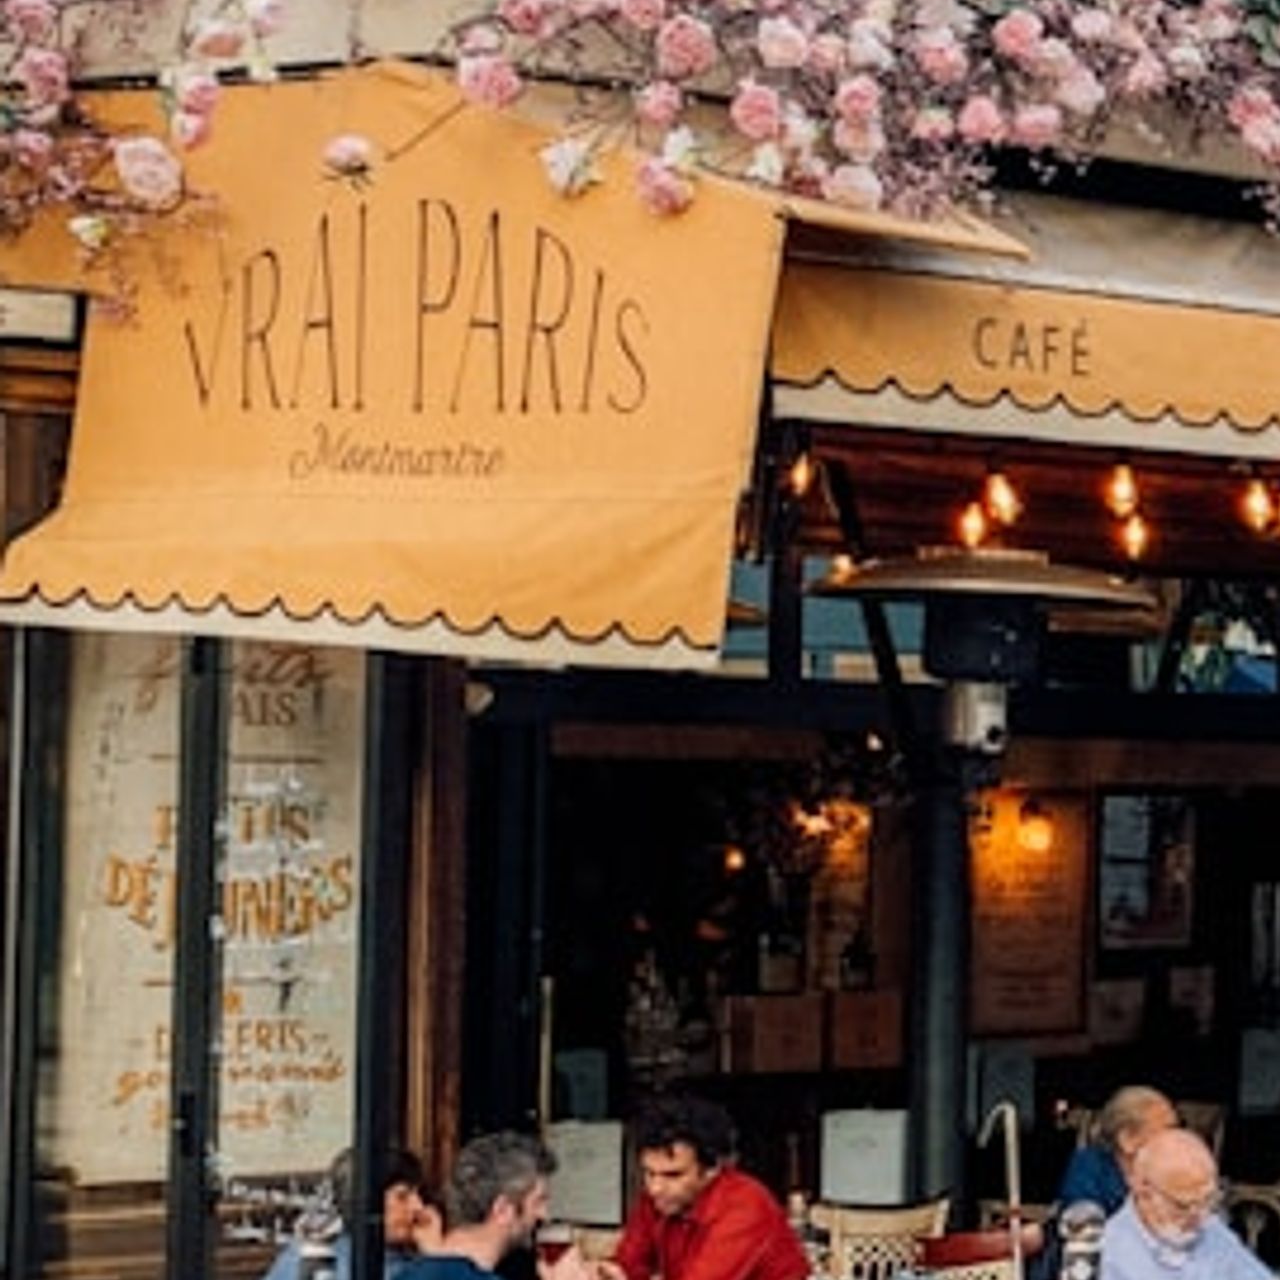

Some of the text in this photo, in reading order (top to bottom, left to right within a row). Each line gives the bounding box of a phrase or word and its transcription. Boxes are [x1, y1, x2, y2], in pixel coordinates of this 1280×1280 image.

[184, 198, 652, 415] VRAI PARIS
[973, 317, 1092, 377] CAFÉ
[288, 421, 506, 480] Montmartre
